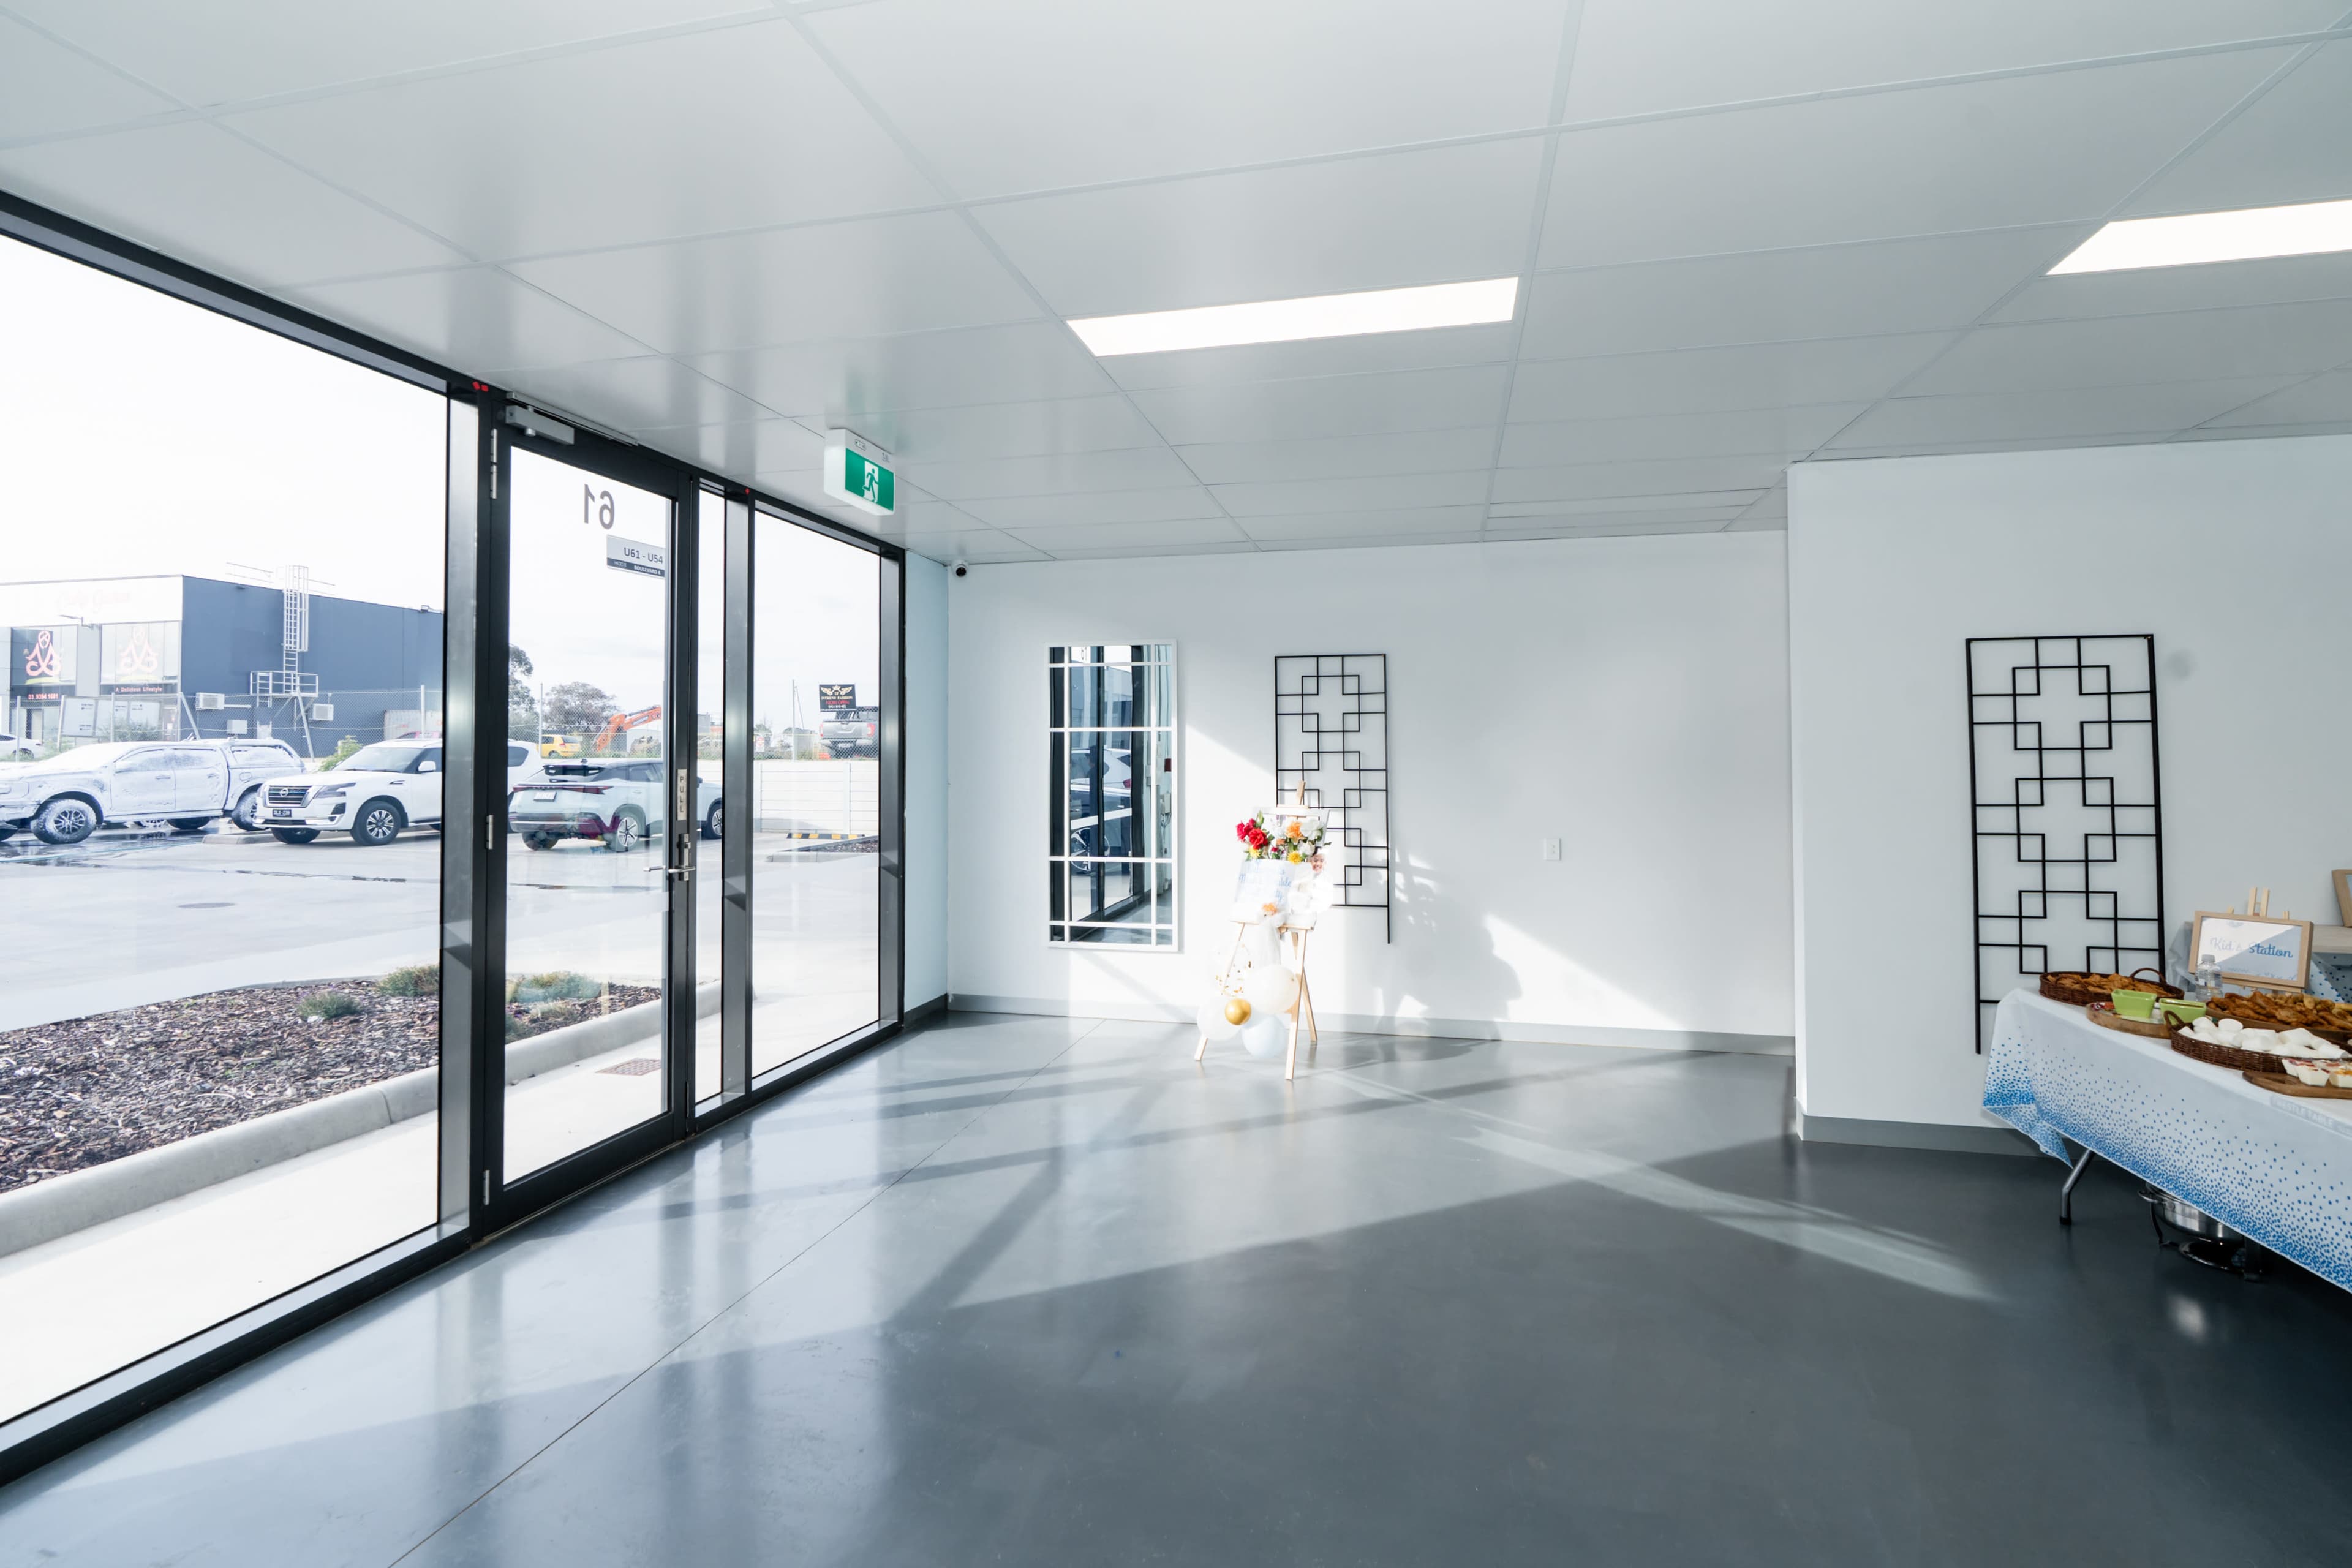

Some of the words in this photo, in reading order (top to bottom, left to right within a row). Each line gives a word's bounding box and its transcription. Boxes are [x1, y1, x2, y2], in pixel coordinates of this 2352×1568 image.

[624, 547, 640, 559] U61
[648, 552, 663, 564] U54
[634, 565, 658, 575] BOULEVARD
[2210, 936, 2244, 951] Kid's
[2248, 941, 2294, 958] Station
